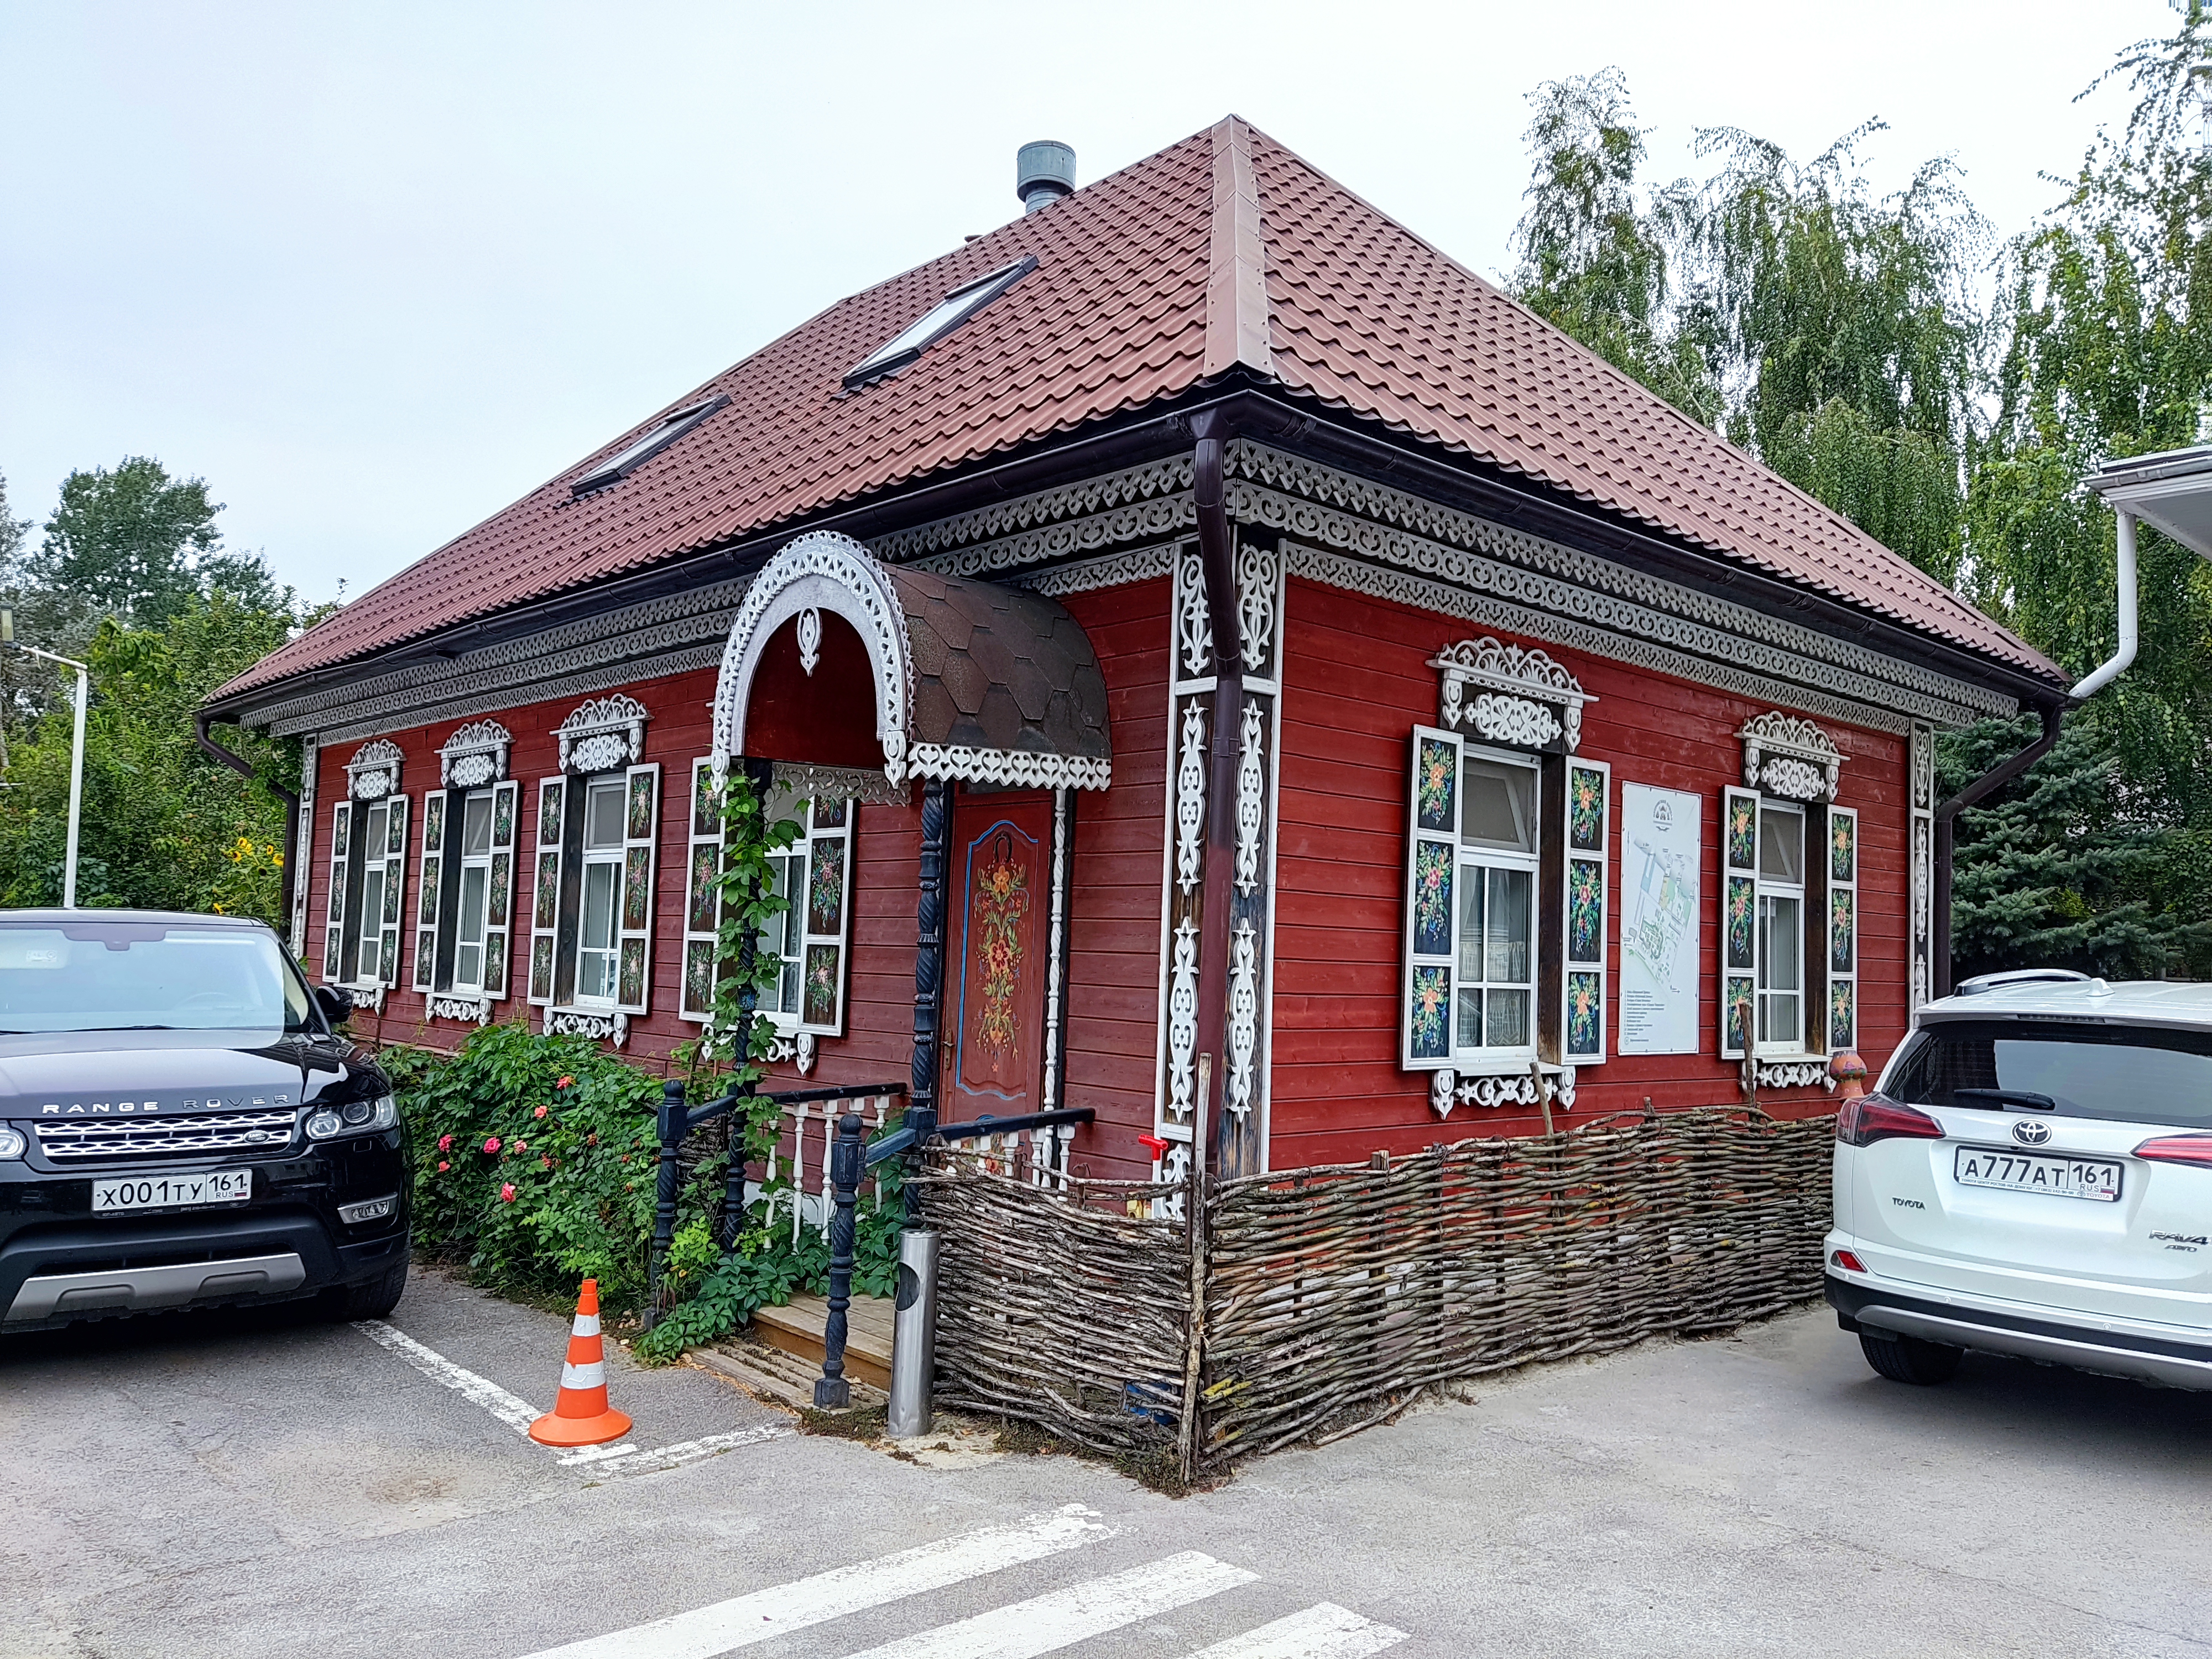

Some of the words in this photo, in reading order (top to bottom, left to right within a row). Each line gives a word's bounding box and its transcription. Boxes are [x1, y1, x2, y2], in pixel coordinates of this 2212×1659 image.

[43, 1102, 158, 1114] RANGE
[182, 1094, 289, 1109] ROVER
[1964, 1155, 2065, 1187] А777АТ
[2072, 1164, 2111, 1186] 161
[208, 1173, 244, 1192] 161
[2080, 1183, 2099, 1192] RUS
[1892, 1197, 1926, 1210] TOYOTA
[2148, 1229, 2209, 1245] RAV4
